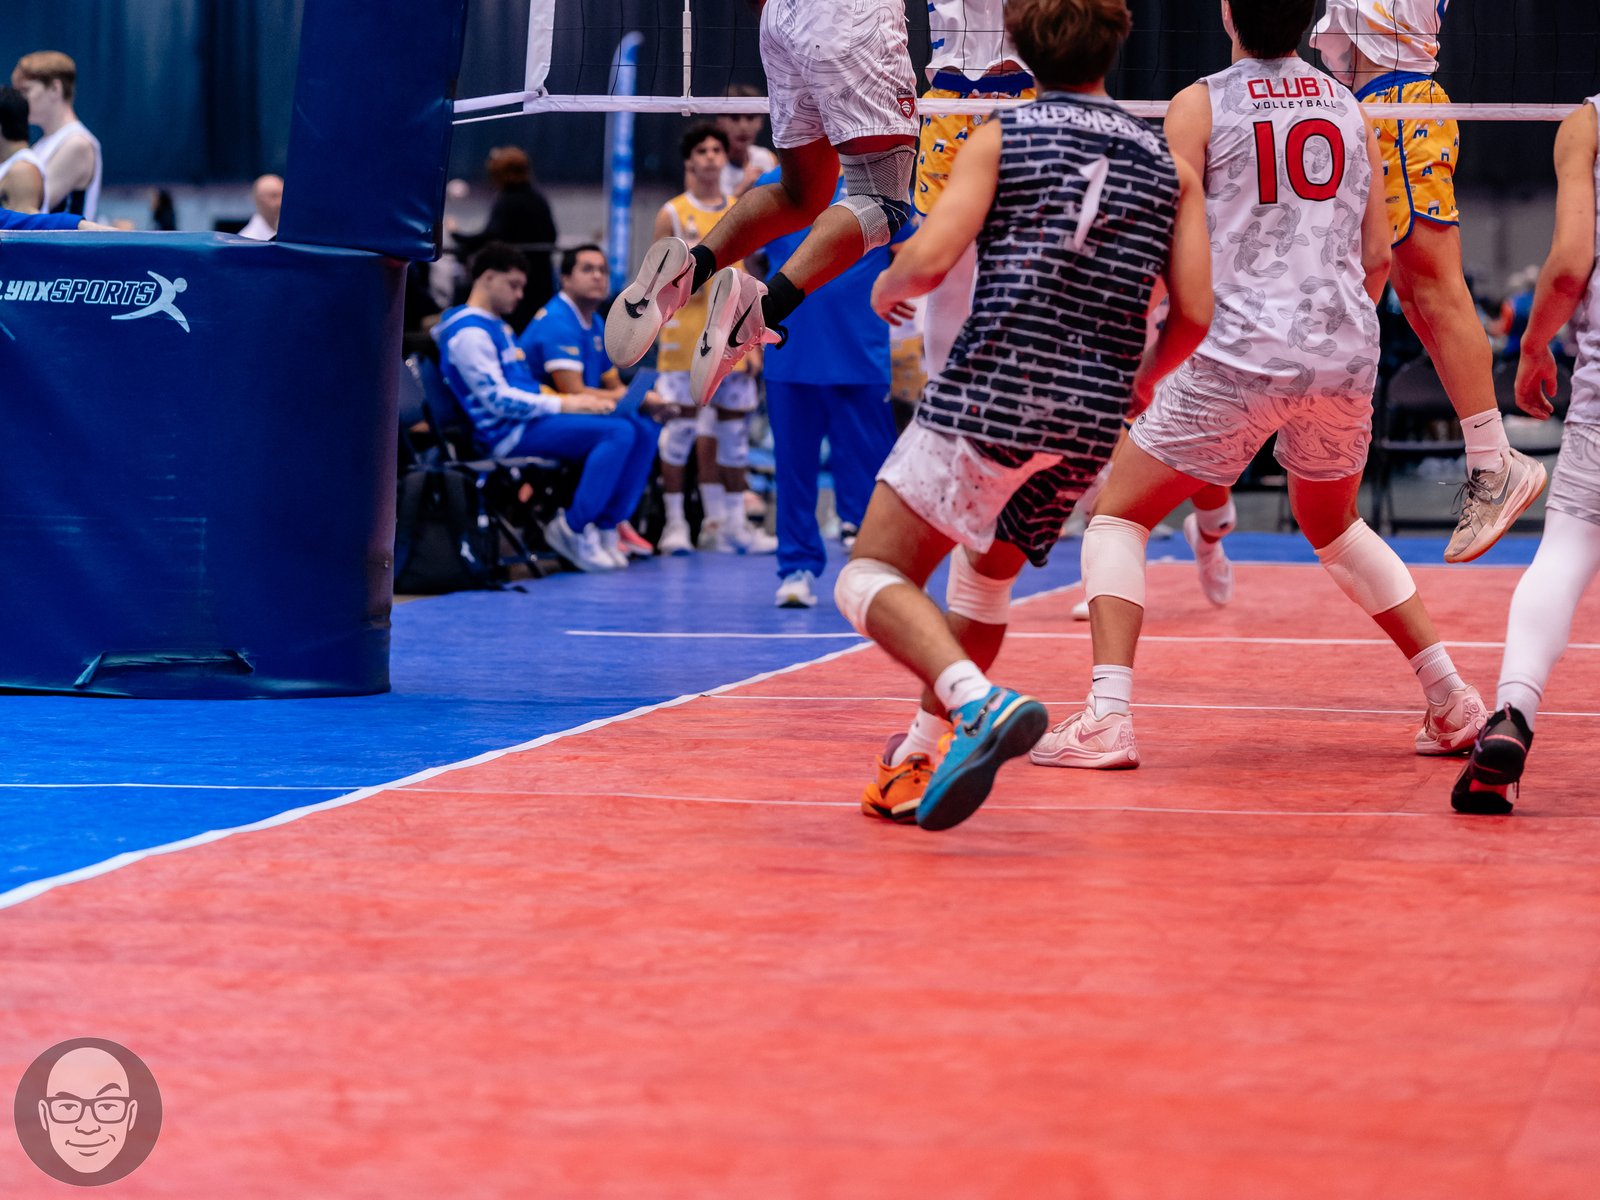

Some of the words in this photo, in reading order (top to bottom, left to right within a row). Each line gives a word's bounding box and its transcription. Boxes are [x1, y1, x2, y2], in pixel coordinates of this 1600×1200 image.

[1247, 77, 1320, 99] CLUB
[1252, 100, 1337, 110] VOLLEYBALL
[1252, 117, 1346, 205] 10
